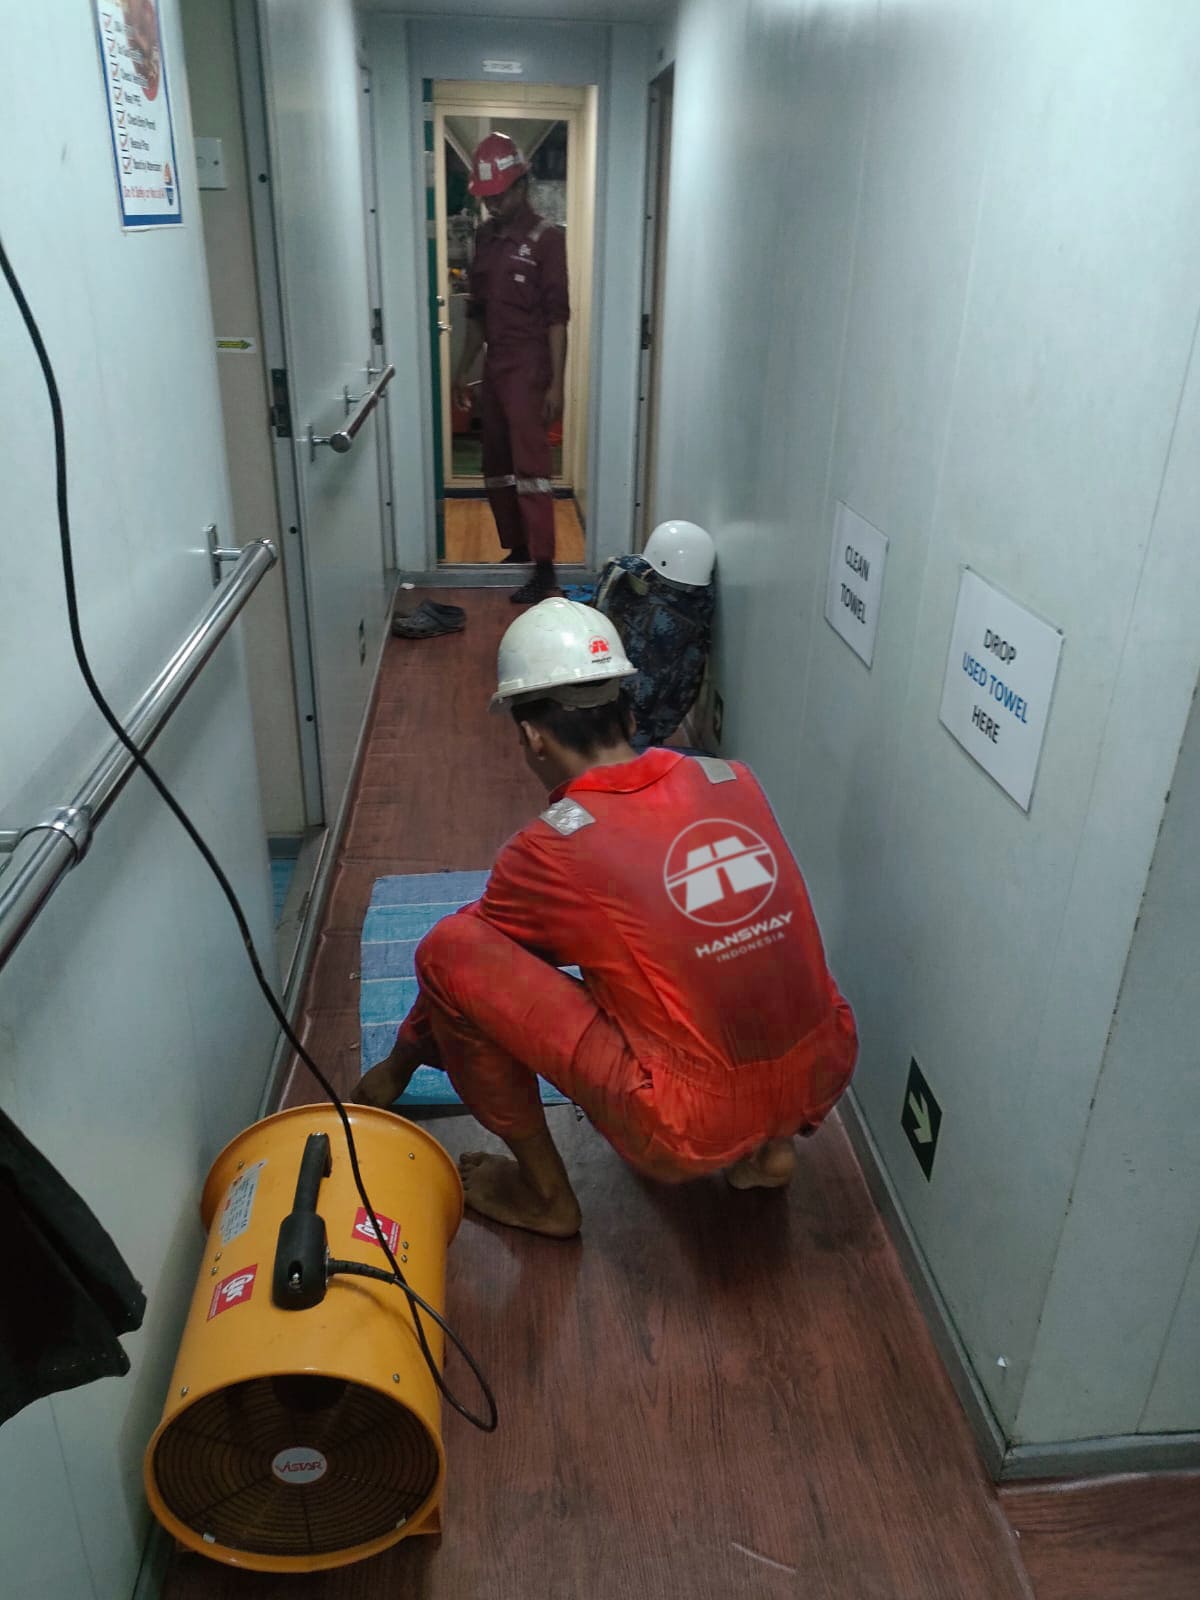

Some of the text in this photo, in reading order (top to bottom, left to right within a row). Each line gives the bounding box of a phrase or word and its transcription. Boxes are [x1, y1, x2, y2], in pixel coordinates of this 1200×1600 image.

[845, 545, 870, 581] CLEAN
[841, 583, 866, 624] TOWEL
[984, 628, 1016, 665] DROP
[962, 651, 1028, 724] USED TOWEL
[972, 704, 1000, 744] HERE
[695, 911, 793, 958] HANSWAY
[716, 931, 785, 963] INDONESIA
